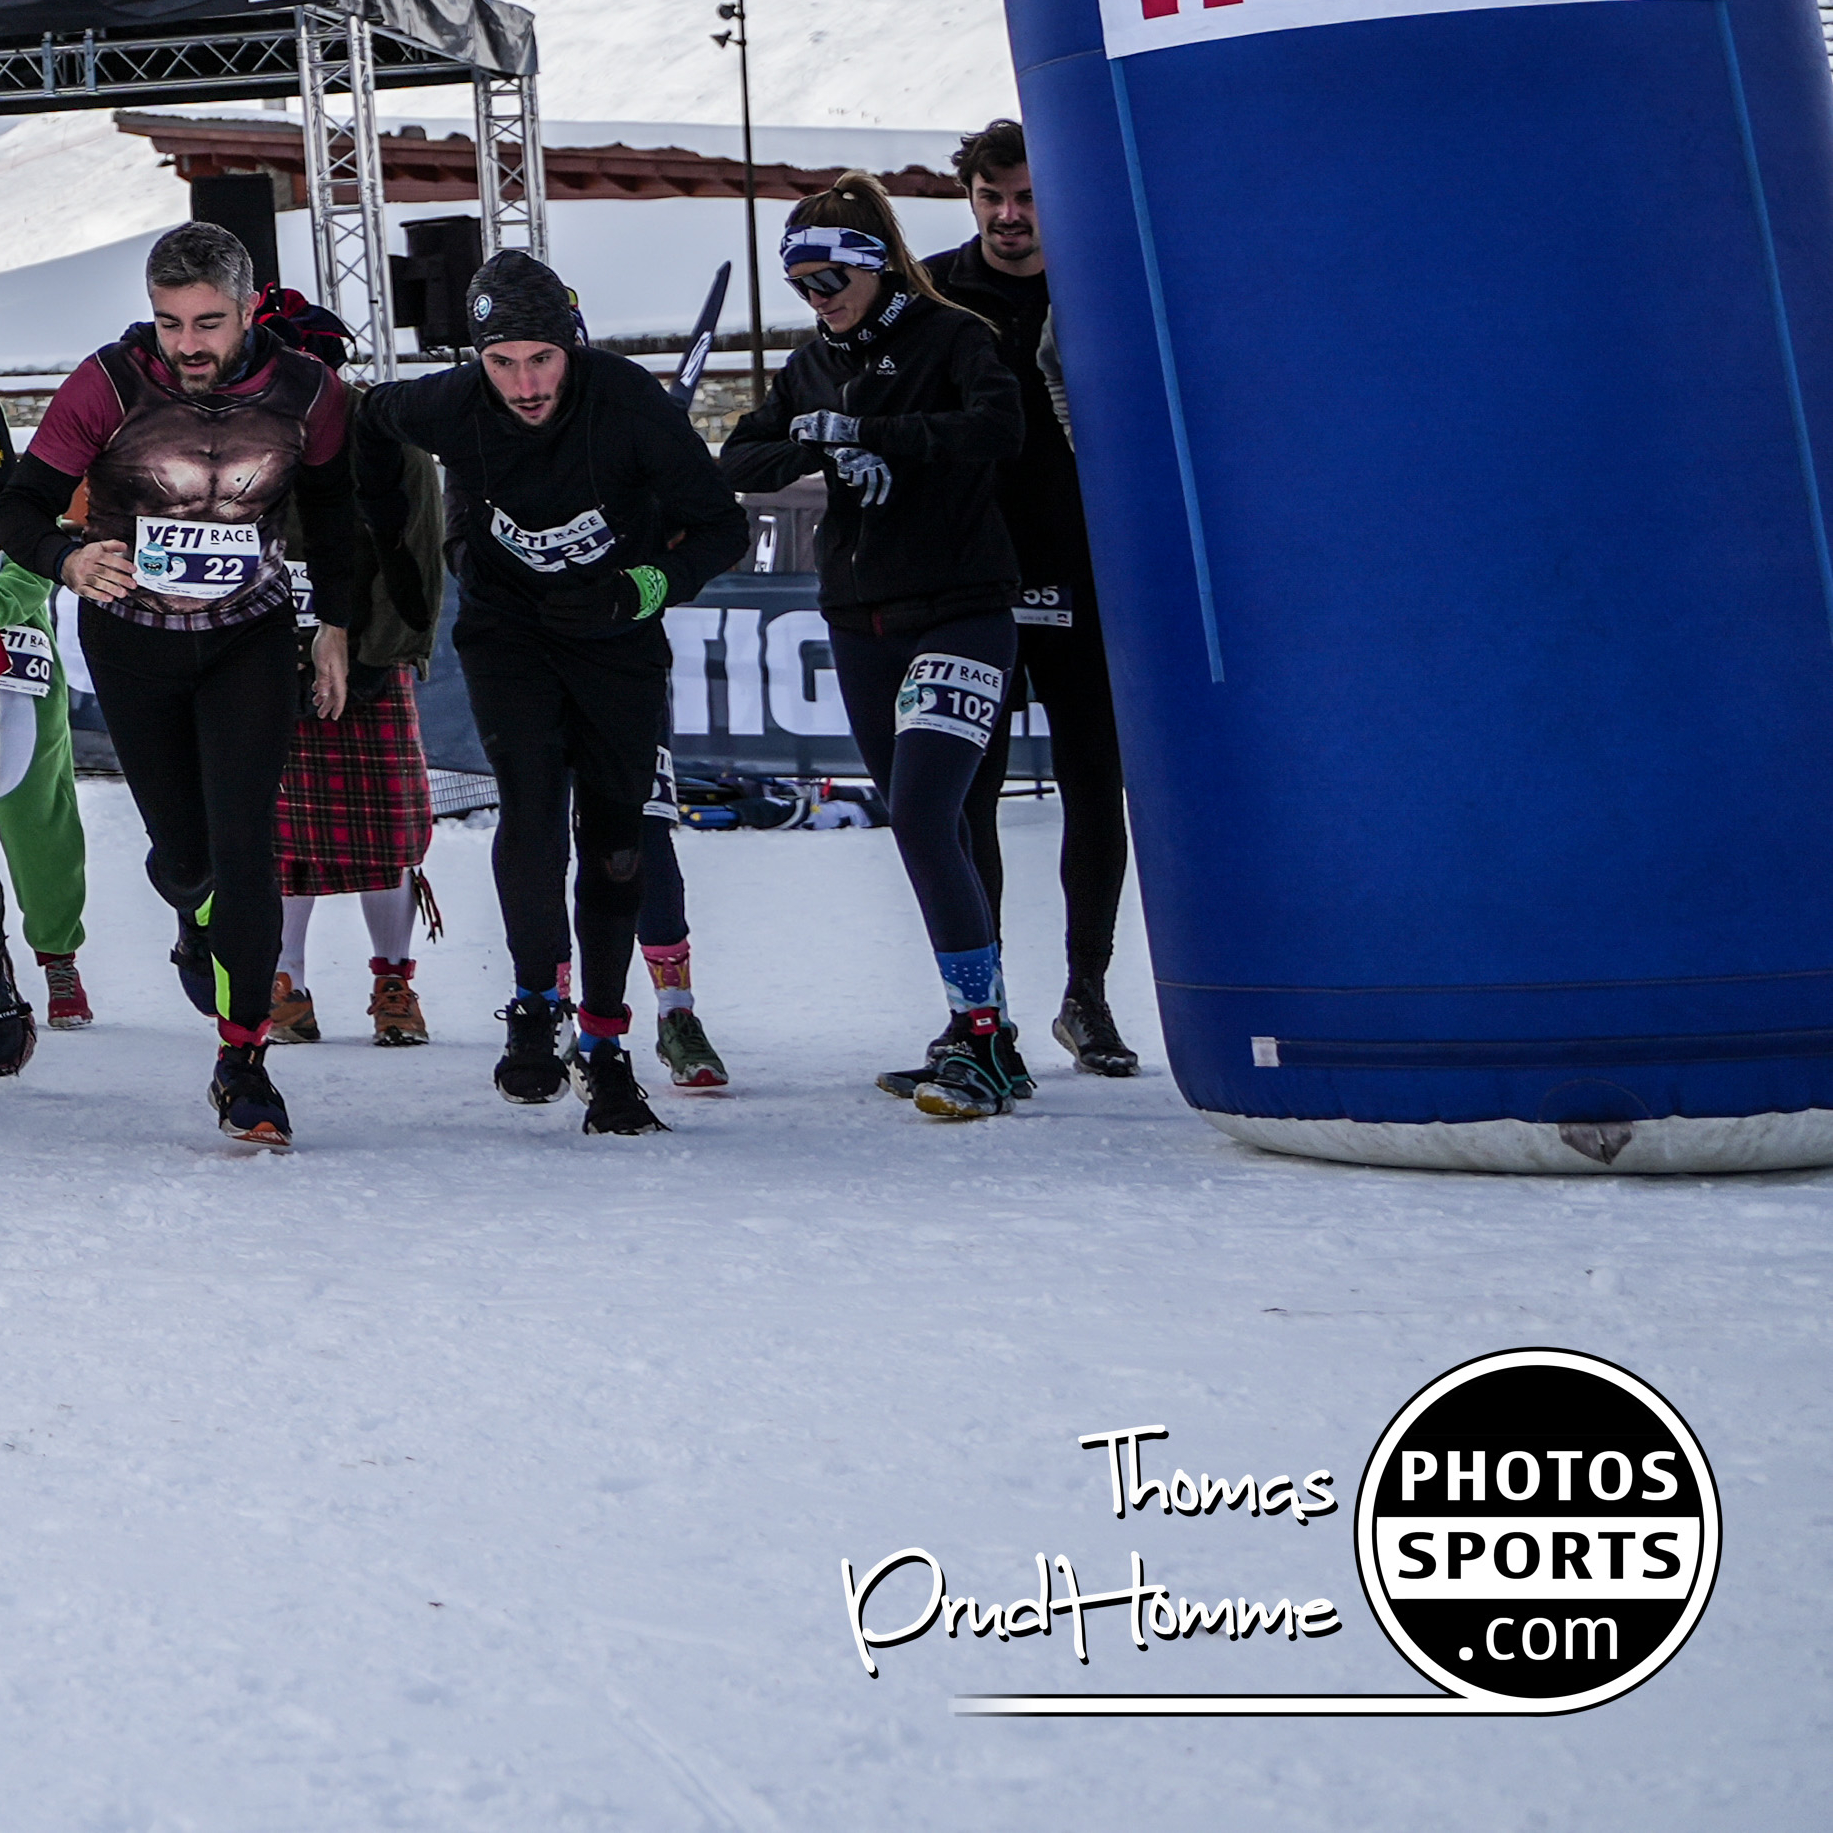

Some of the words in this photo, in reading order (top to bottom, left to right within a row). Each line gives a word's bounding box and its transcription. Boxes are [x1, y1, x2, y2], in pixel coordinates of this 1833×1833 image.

[878, 291, 909, 327] TIGNES
[210, 529, 254, 545] RACE
[203, 557, 244, 581] 22
[25, 657, 50, 682] 60
[960, 665, 999, 689] RACE
[947, 691, 995, 728] 102
